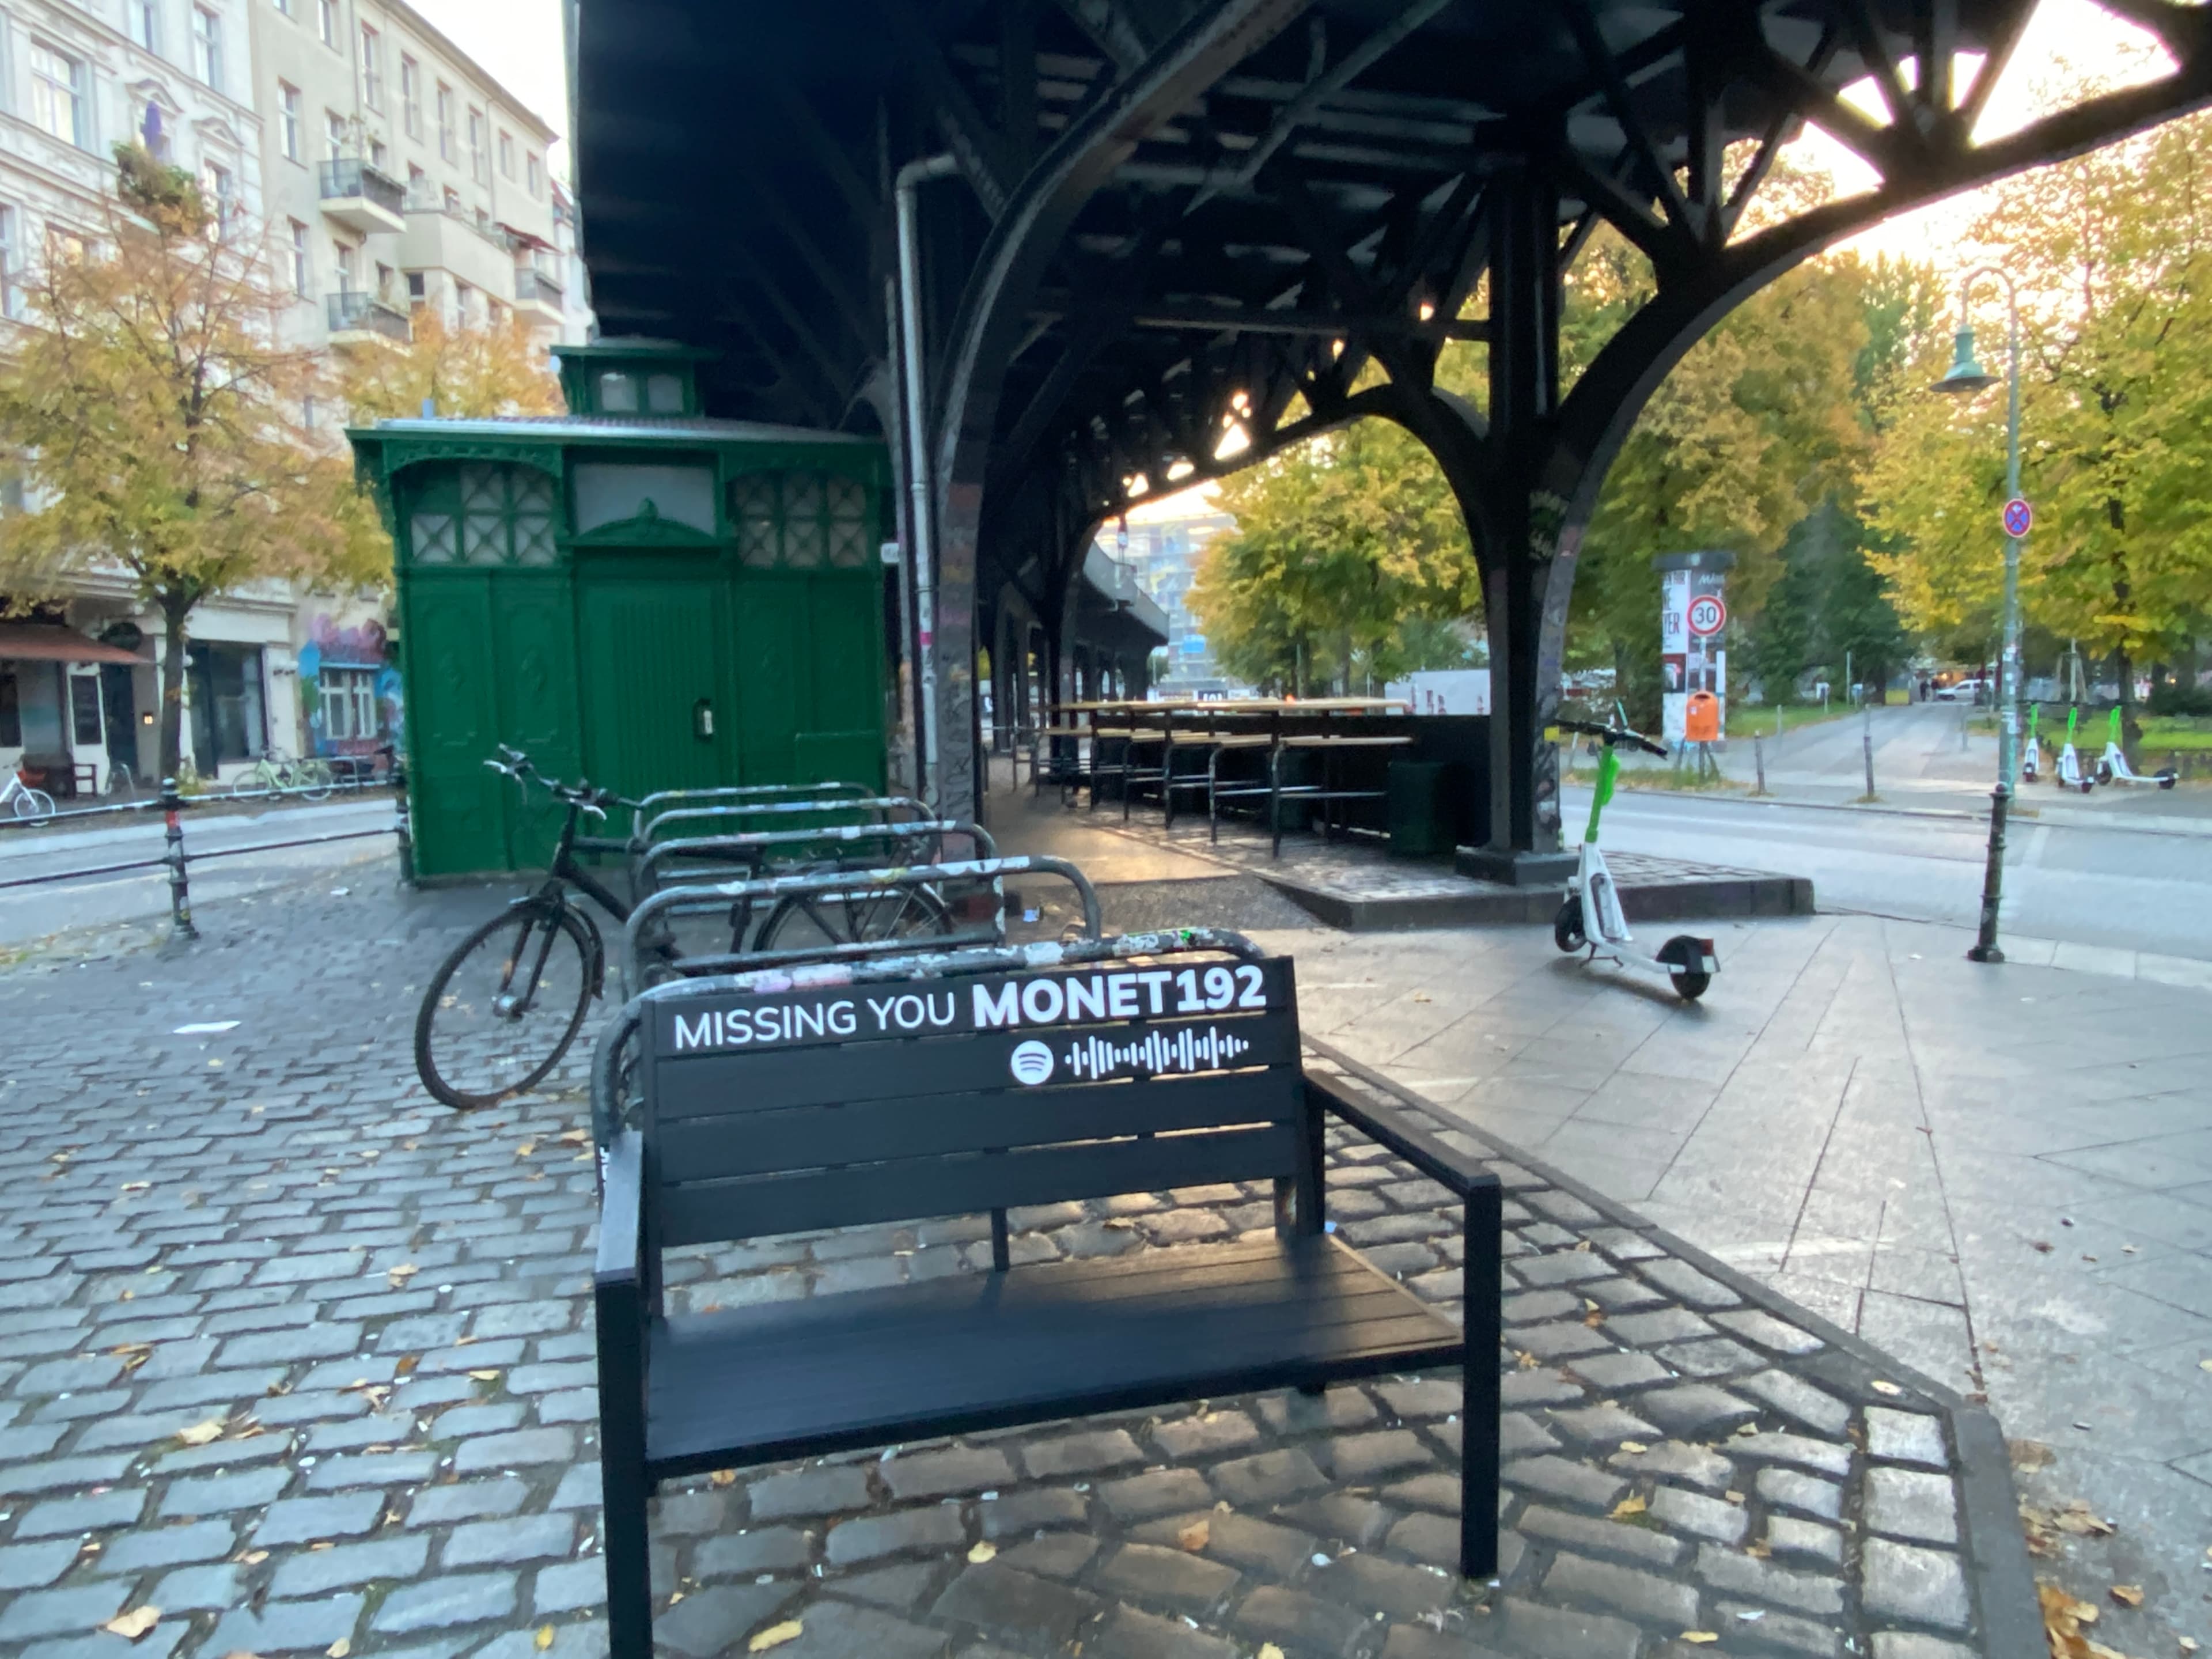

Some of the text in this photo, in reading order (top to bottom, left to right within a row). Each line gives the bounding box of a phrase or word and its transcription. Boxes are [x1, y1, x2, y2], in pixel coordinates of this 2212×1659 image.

[1695, 606, 1717, 624] 30
[674, 965, 1267, 1050] MISSING YOU MONET192
